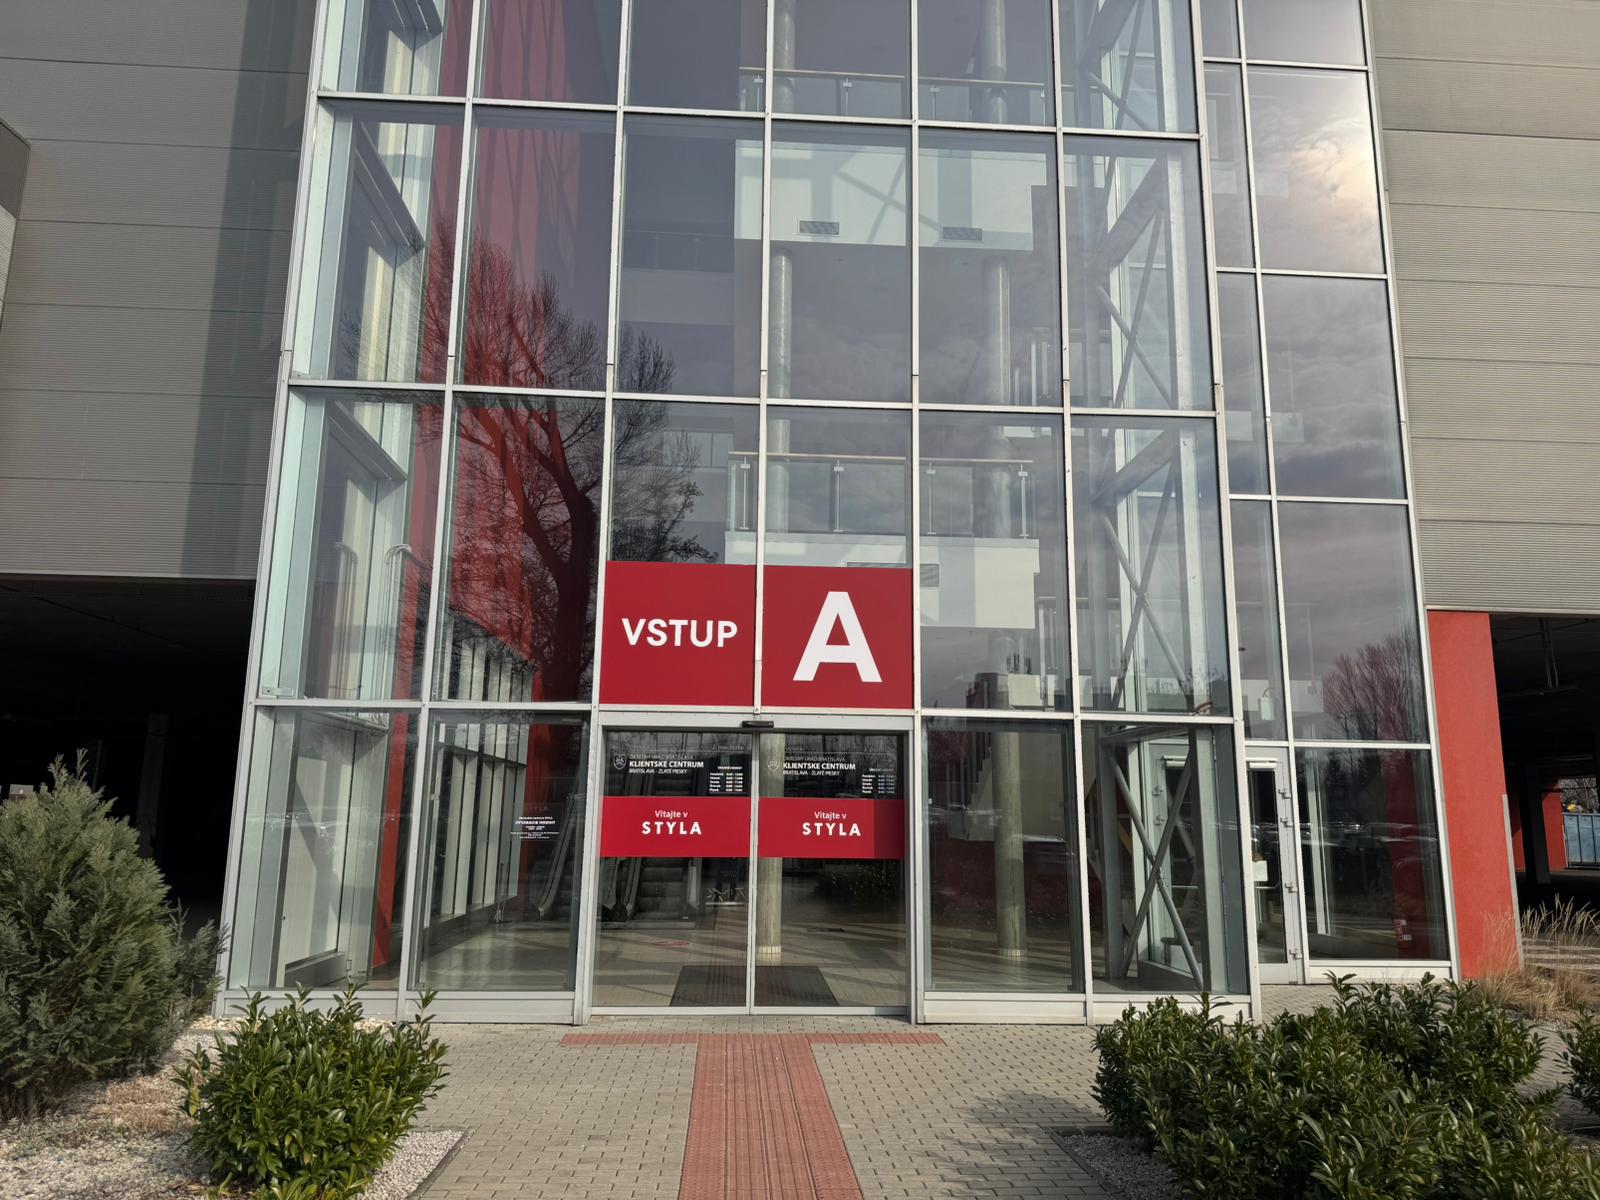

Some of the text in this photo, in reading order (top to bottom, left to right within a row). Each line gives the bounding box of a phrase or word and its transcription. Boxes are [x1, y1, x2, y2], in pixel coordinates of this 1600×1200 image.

[621, 591, 883, 683] VSTUP A
[629, 760, 704, 769] KLIENTSKE CENTRUM
[821, 763, 856, 771] CENTRUM
[654, 809, 681, 820] Vitajte
[814, 811, 840, 821] Vitajte
[641, 821, 702, 835] STYLA
[802, 822, 861, 836] STYLA
